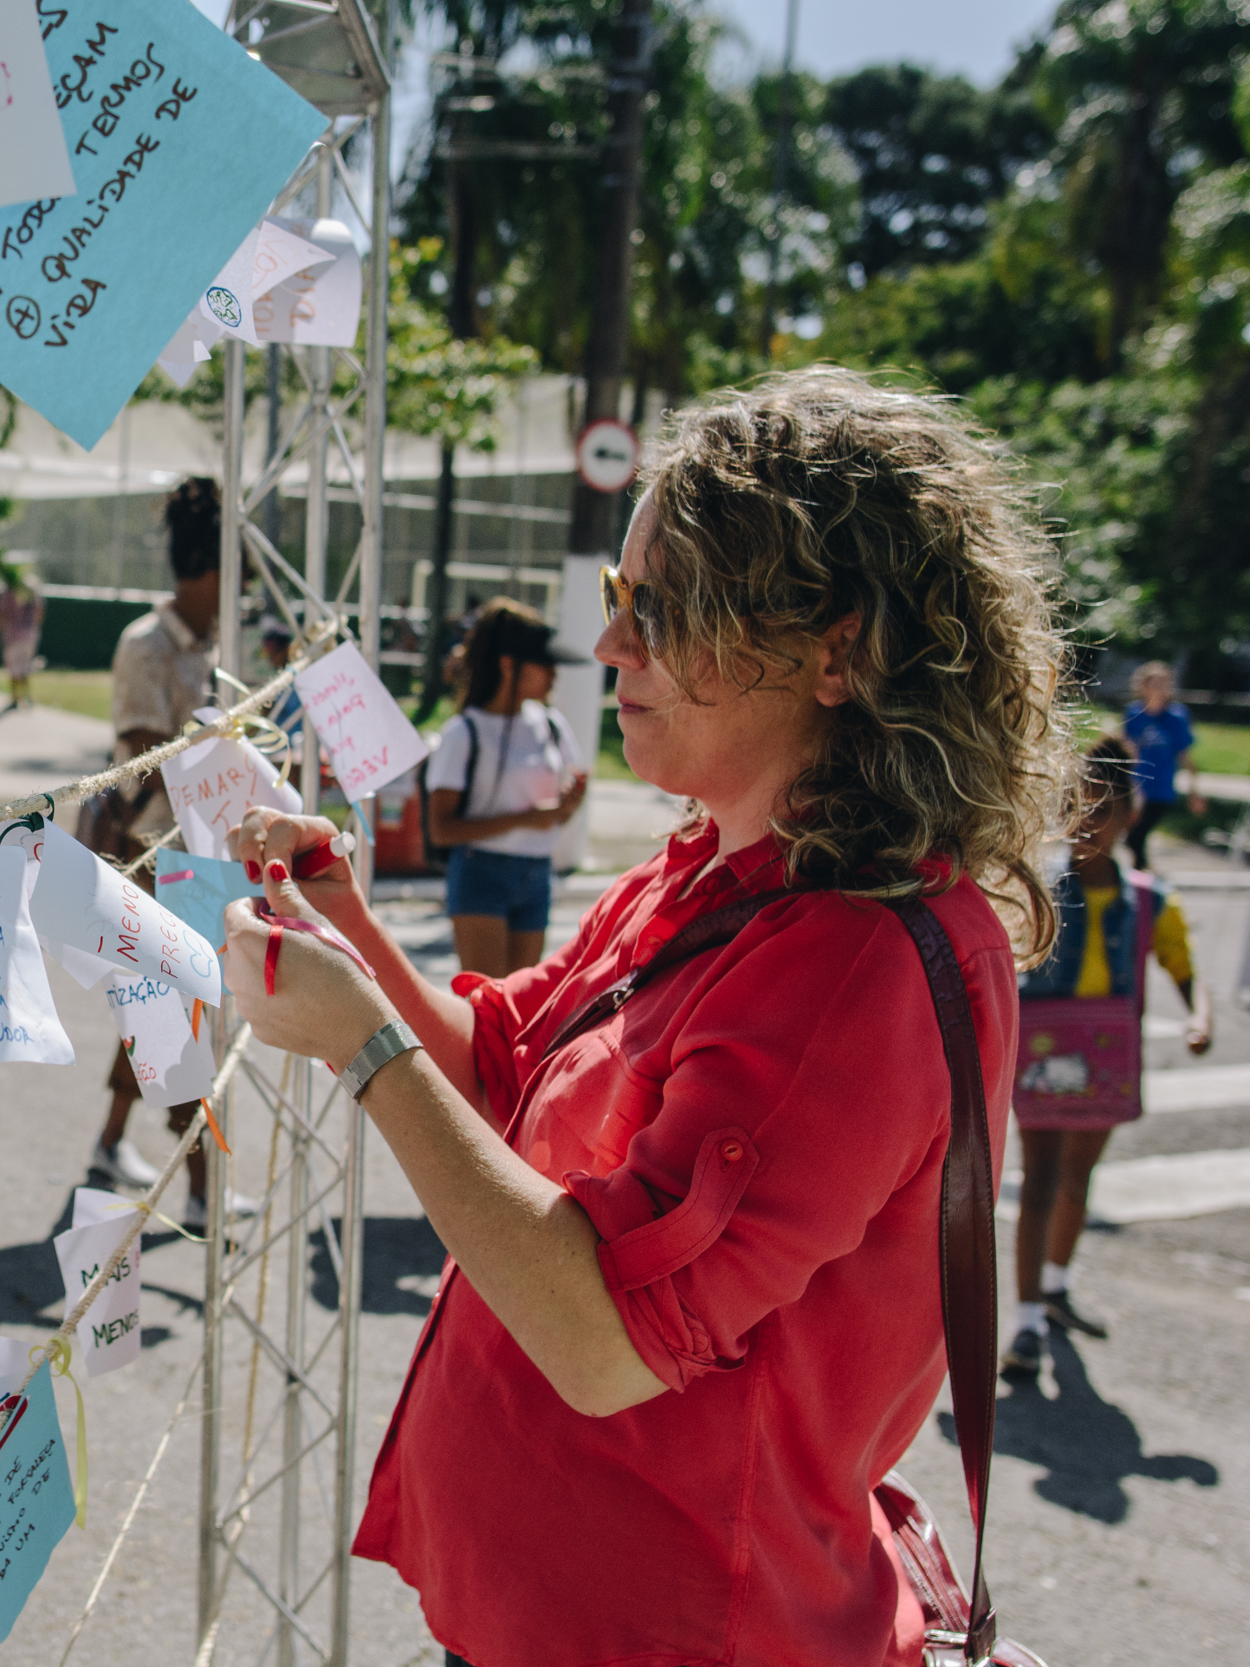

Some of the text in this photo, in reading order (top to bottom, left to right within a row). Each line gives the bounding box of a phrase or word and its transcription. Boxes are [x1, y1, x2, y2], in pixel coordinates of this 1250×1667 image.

[56, 22, 118, 110] EÇAM
[2, 196, 61, 260] TODO
[75, 42, 165, 157] TERMOS
[41, 133, 161, 283] QUALIDADE
[155, 78, 198, 122] DE
[44, 276, 107, 348] VIDA
[116, 874, 141, 963] MENO
[160, 906, 181, 980] PREC
[106, 974, 171, 1010] TIZAÇÃO
[31, 1468, 51, 1496] DE
[16, 1523, 35, 1552] UM
